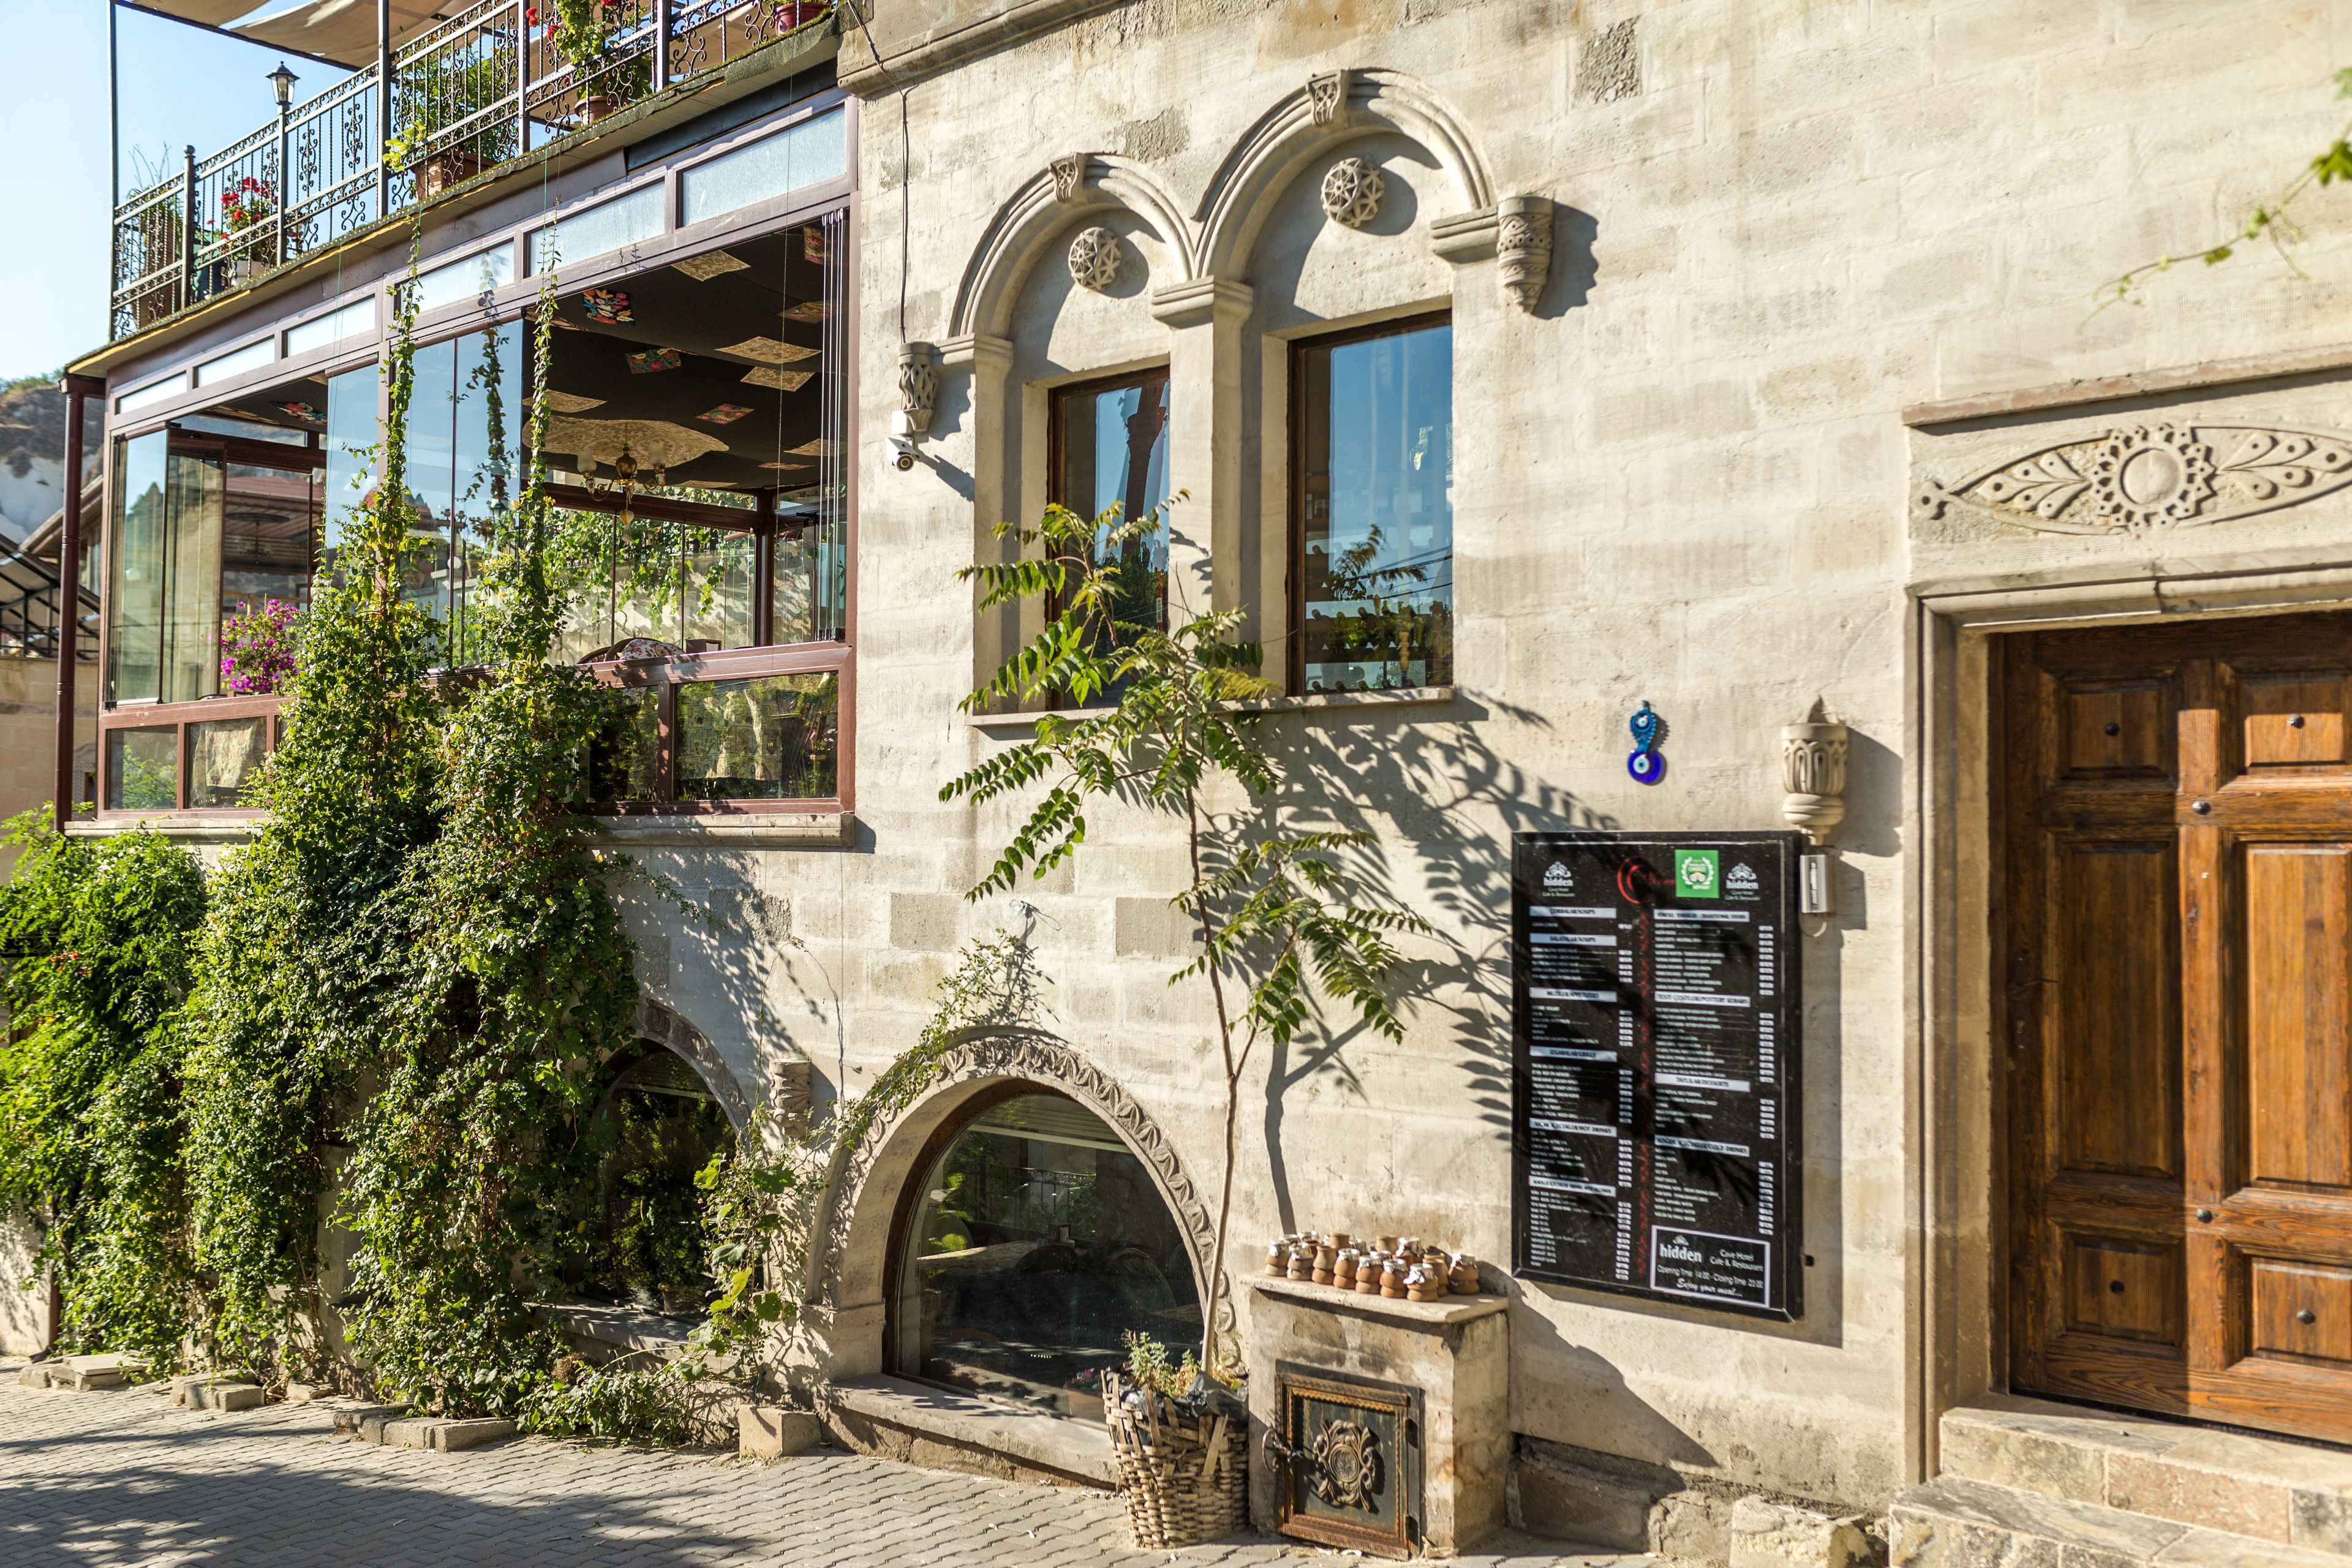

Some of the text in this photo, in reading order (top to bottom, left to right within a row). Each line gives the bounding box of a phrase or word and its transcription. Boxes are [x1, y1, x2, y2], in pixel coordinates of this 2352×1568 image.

[1543, 877, 1574, 887] hidden
[1725, 880, 1759, 889] hidden
[1659, 1243, 1702, 1263] hidden
[1719, 1249, 1754, 1262] Cave Hotel
[1725, 1258, 1731, 1267] &
[1732, 1259, 1763, 1272] Restaurant
[1657, 1264, 1680, 1277] Opening
[1713, 1273, 1733, 1286] Closing
[1700, 1284, 1716, 1293] your
